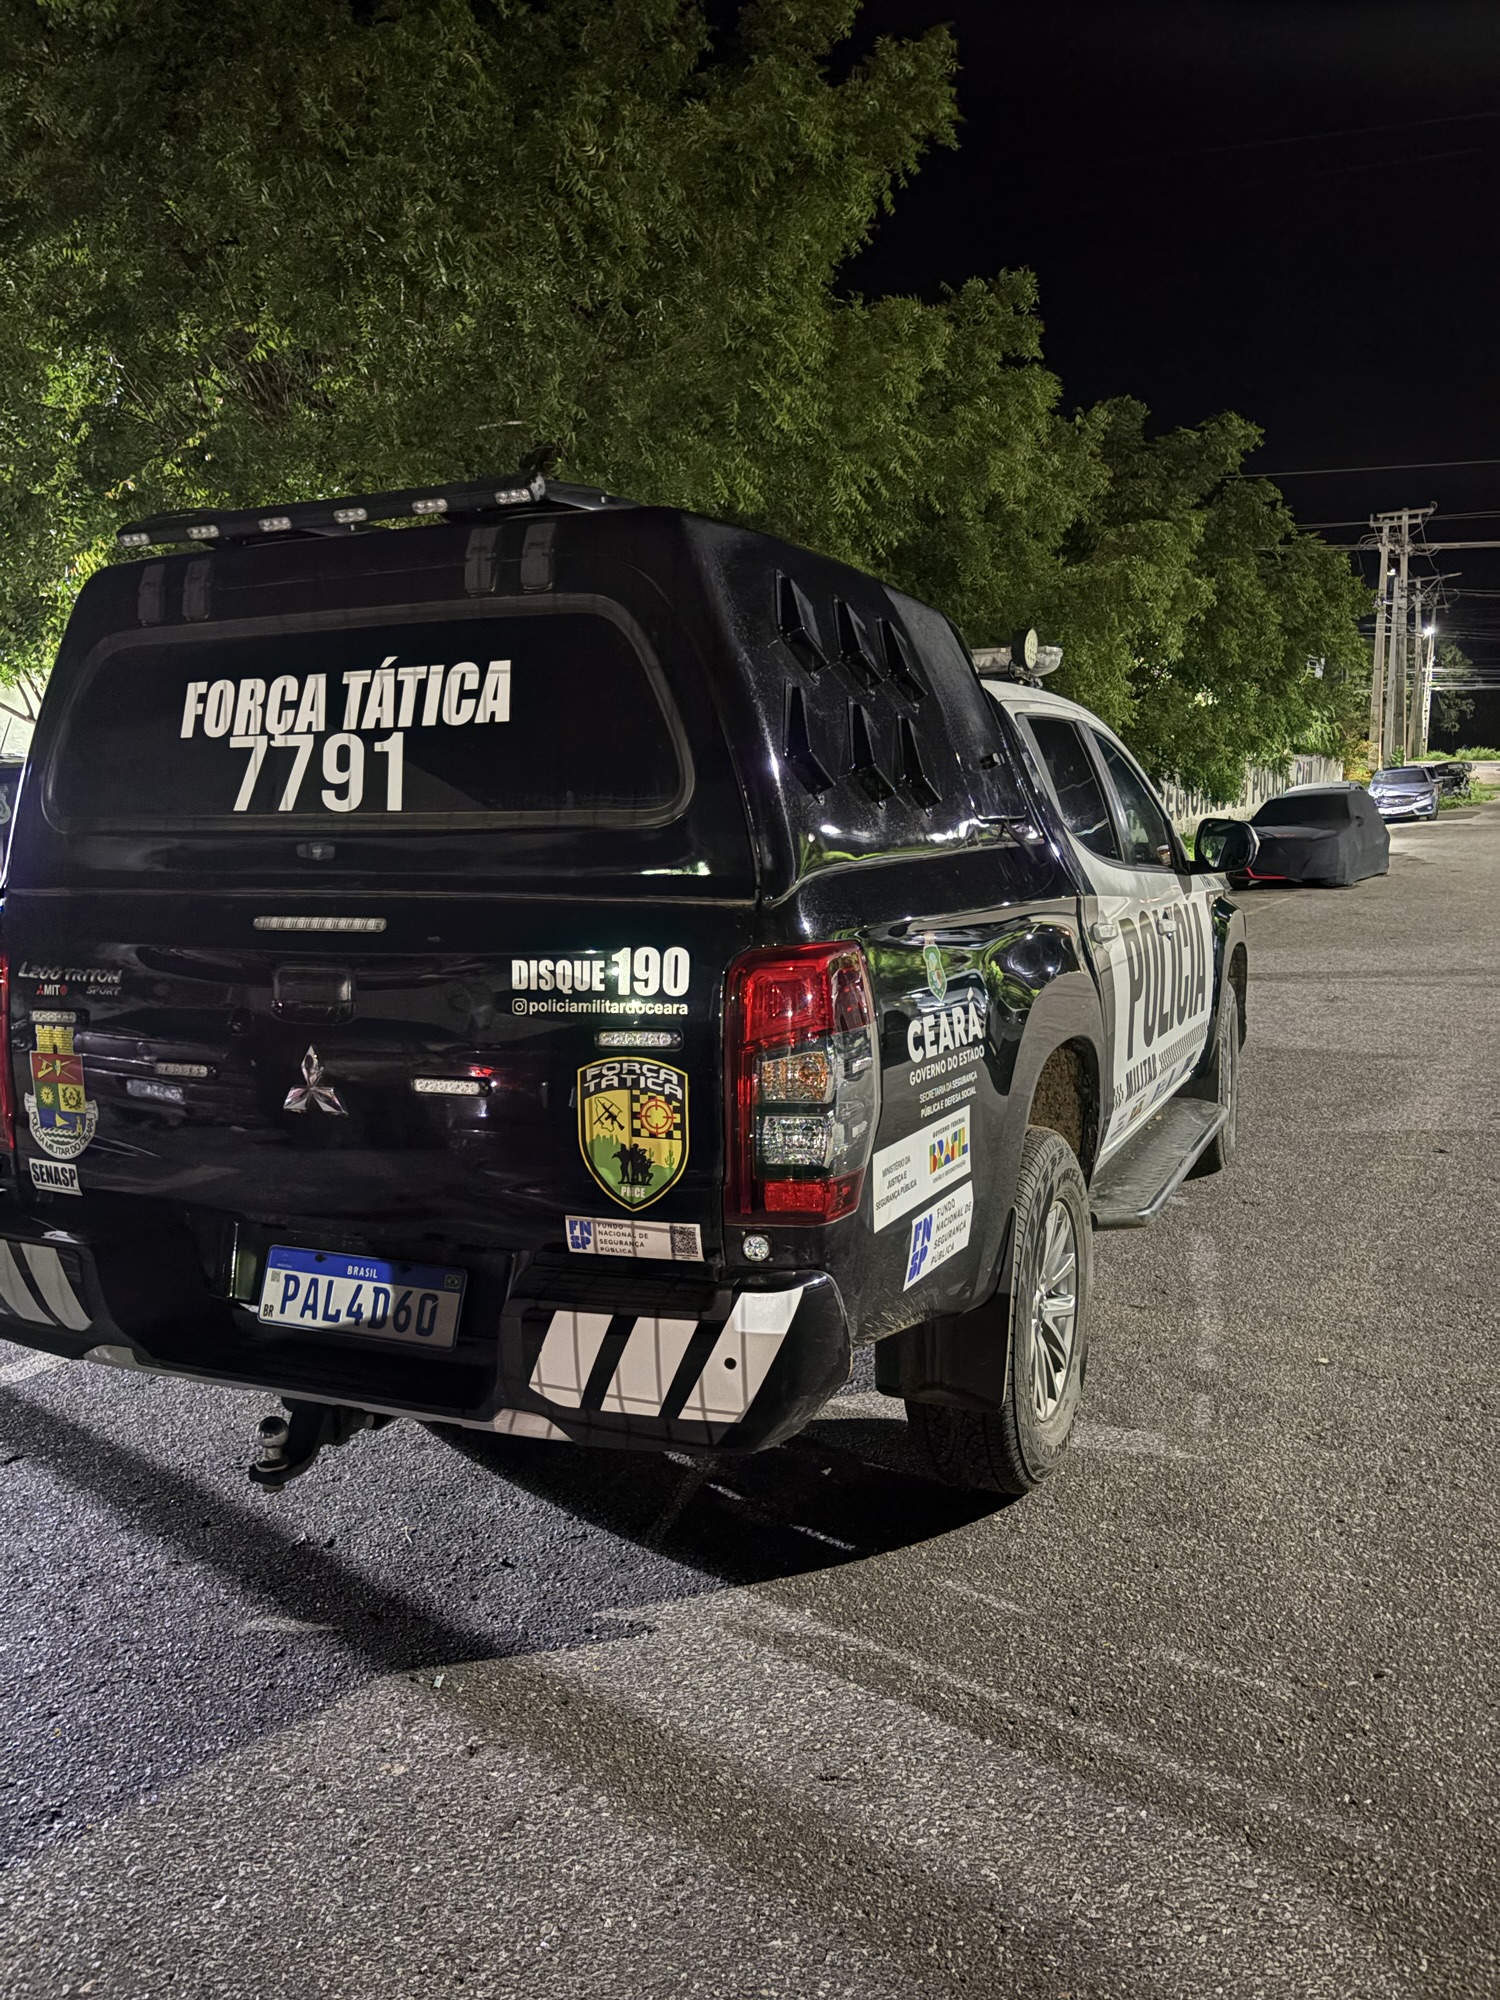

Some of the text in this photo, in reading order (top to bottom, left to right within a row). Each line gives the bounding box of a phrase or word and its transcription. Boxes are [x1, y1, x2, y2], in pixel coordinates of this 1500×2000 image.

[180, 656, 511, 746] FORÇA TÁTICA
[229, 731, 404, 812] 7791
[18, 961, 122, 983] L200 TRITON
[512, 946, 690, 997] DISQUE 190
[86, 985, 122, 996] SPORT
[529, 999, 688, 1015] policiamilitardoceara
[907, 987, 984, 1063] CEARÁ
[586, 1062, 678, 1085] FORÇA
[909, 1044, 985, 1086] GOVERNO DO ESTADO
[920, 1070, 978, 1103] SECRETARIA DA SEGURANÇA
[1125, 1053, 1158, 1103] MILITAR
[921, 1102, 940, 1118] PÚBLICA
[944, 1093, 961, 1107] DEFESA
[961, 1086, 977, 1099] SOCIAL
[45, 1142, 71, 1156] MILITAR
[70, 1142, 80, 1153] DO
[904, 1155, 911, 1165] DA
[929, 1127, 968, 1175] BRASIL
[31, 1163, 77, 1188] SENASP
[887, 1173, 903, 1189] JUSTIÇA
[875, 1178, 917, 1211] SEGURANÇA PÚBLICA
[936, 1198, 955, 1218] FUNDO
[936, 1201, 972, 1233] NACIONAL DE
[568, 1220, 593, 1237] FN
[597, 1222, 623, 1230] FUNDO
[598, 1230, 636, 1239] NACIONAL
[912, 1213, 933, 1253] FN
[933, 1219, 966, 1249] SEGURANÇA
[570, 1235, 592, 1250] SP
[599, 1239, 645, 1248] SEGURANÇA
[600, 1245, 633, 1254] PÚBLICA
[930, 1241, 955, 1266] PÚBLICA
[347, 1265, 378, 1279] BRASIL
[263, 1303, 274, 1318] BR
[279, 1274, 439, 1337] PAL4D60
